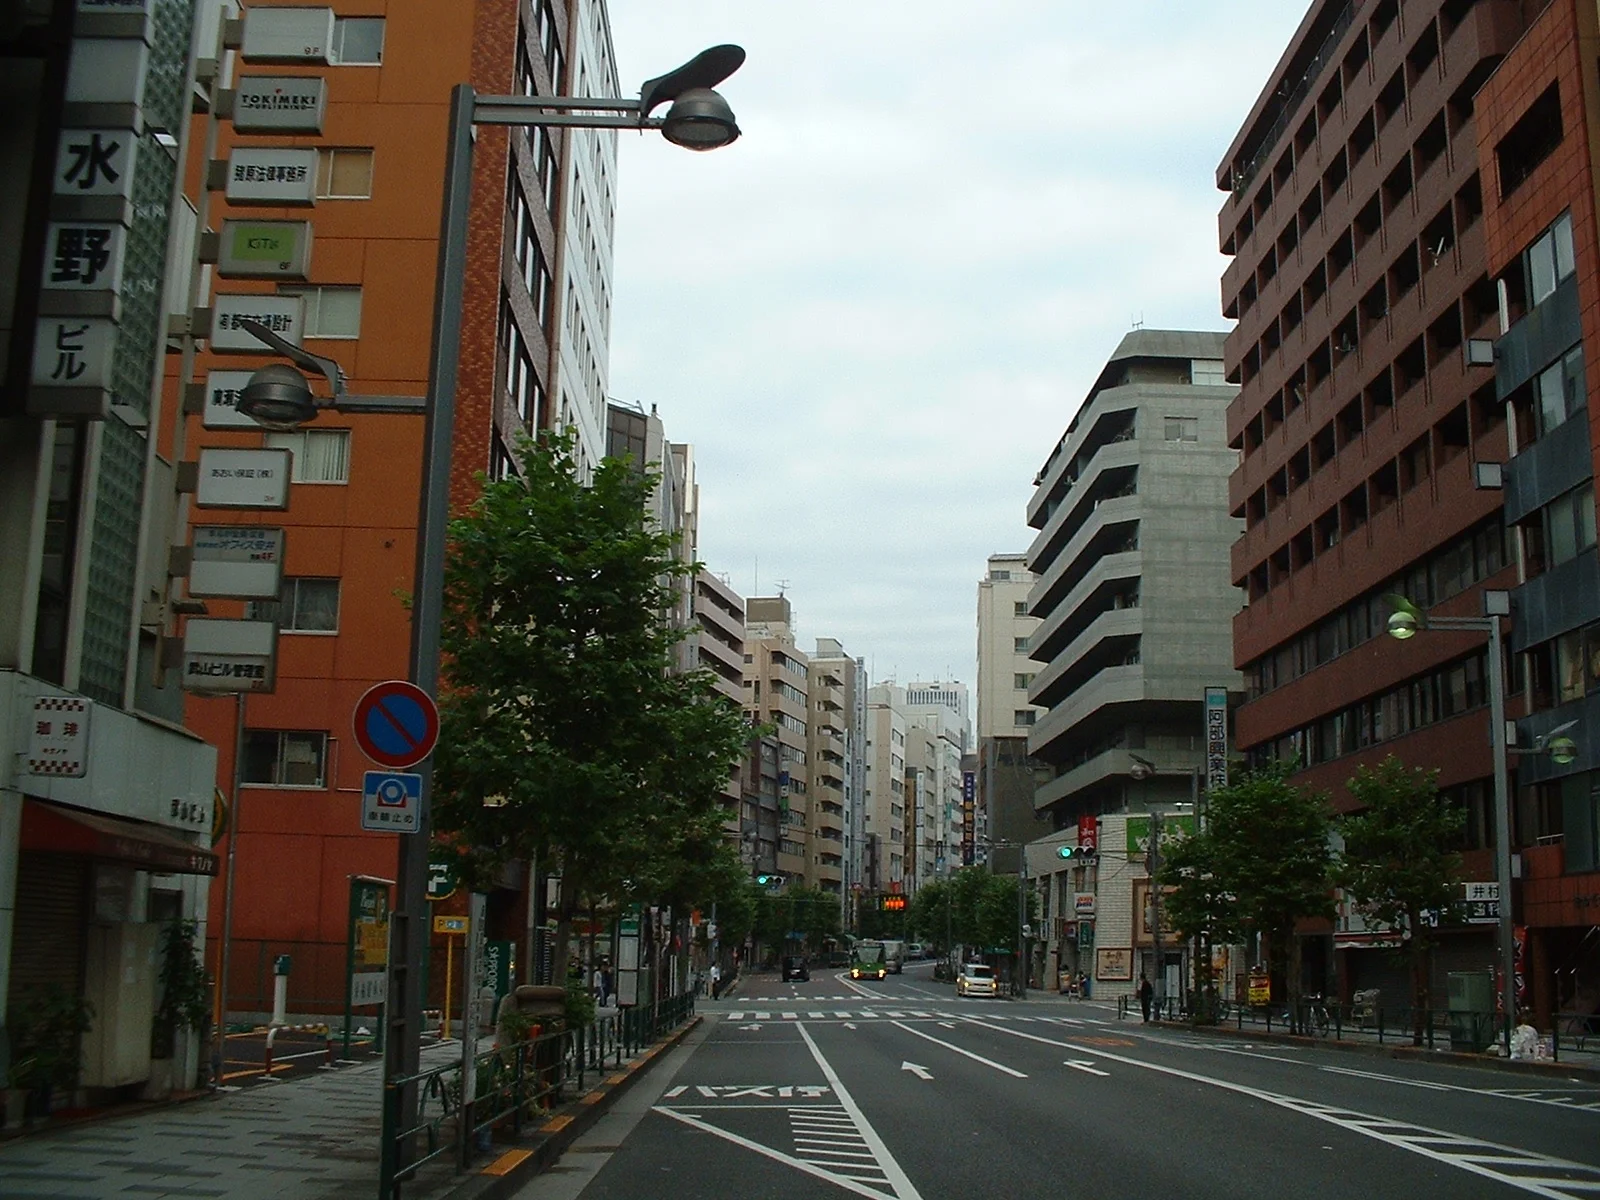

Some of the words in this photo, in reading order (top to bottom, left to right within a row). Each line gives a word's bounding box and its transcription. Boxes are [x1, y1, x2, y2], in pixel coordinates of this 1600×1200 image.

[242, 95, 315, 104] TOKIMEKI
[52, 134, 120, 380] 水野ビル
